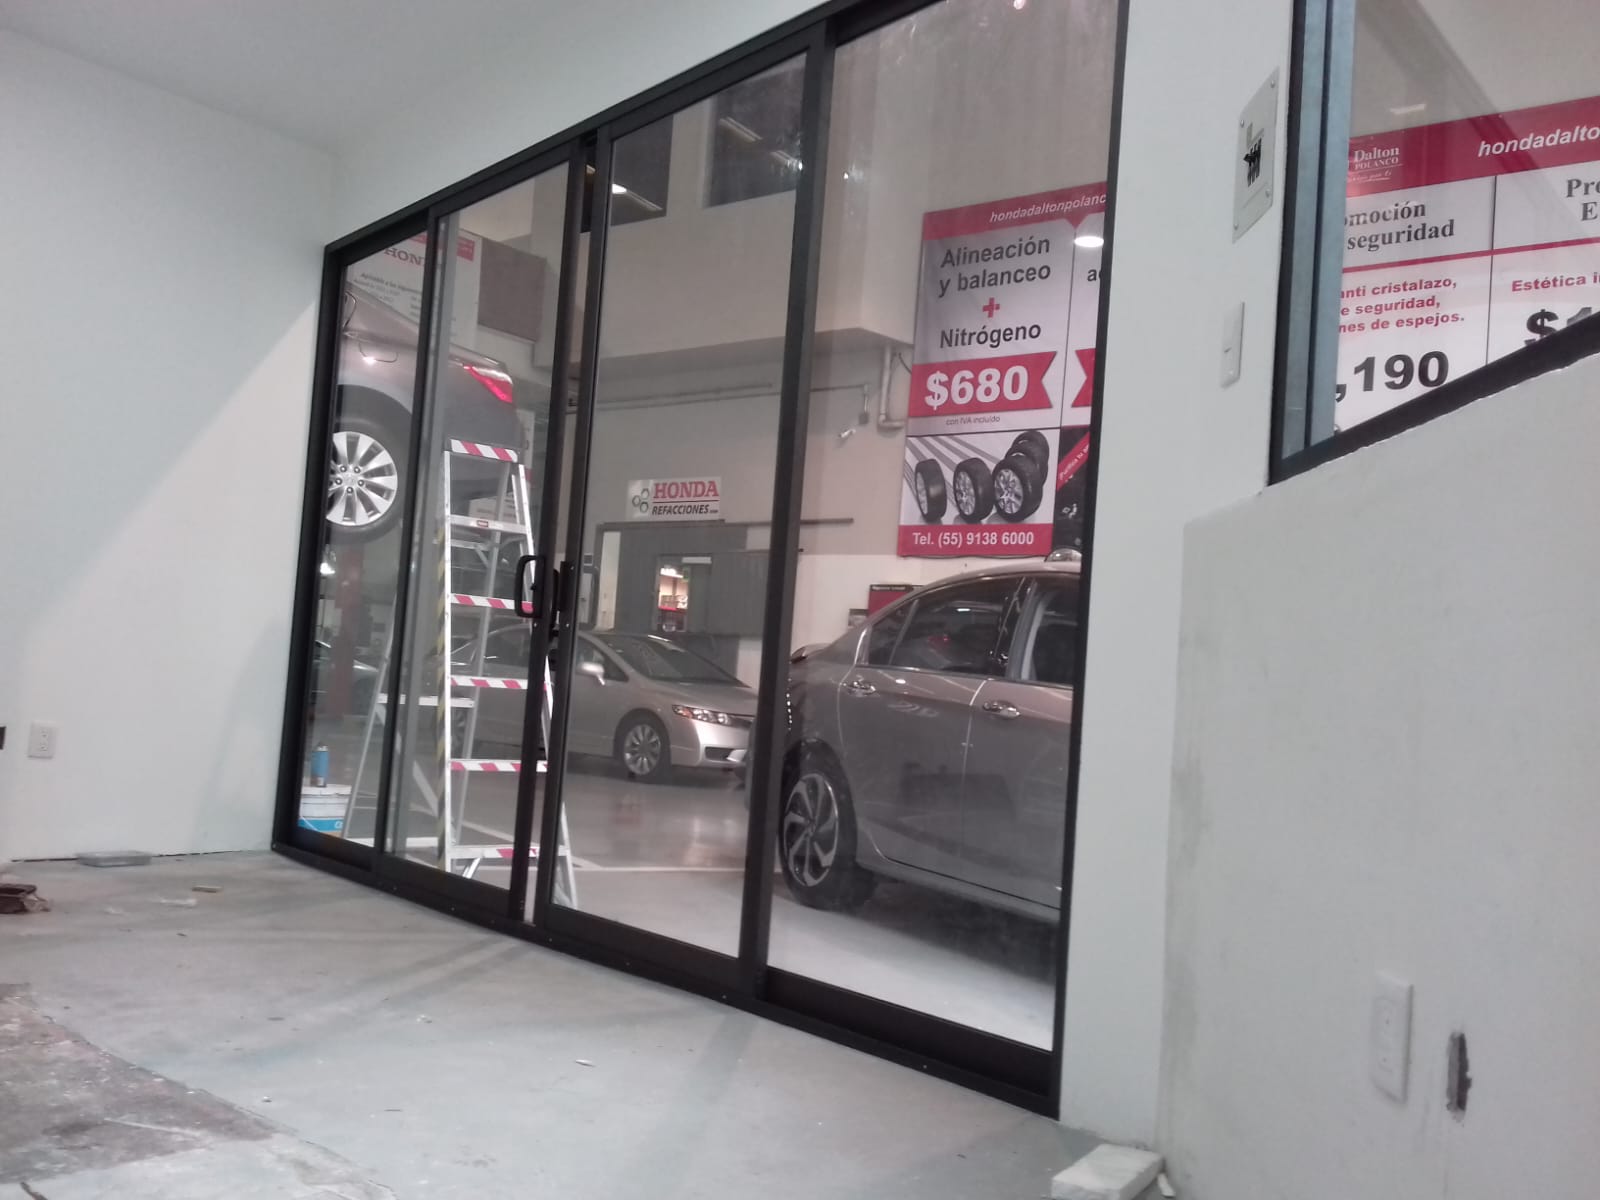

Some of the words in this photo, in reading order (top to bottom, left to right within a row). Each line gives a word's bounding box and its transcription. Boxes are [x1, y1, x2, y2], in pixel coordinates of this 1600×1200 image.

[1478, 125, 1600, 157] hondadalto
[1354, 147, 1400, 162] Dalton
[1343, 201, 1426, 227] moción
[1347, 219, 1455, 252] seguridad
[384, 247, 425, 266] HON
[940, 236, 1050, 268] Alineación
[938, 278, 950, 298] y
[957, 264, 1051, 291] balanceo
[1371, 277, 1457, 296] cristalazo,
[1511, 275, 1586, 292] Estética
[1355, 295, 1441, 315] seguridad,
[1371, 318, 1390, 330] de
[1395, 312, 1465, 328] espejos.
[940, 324, 1041, 349] Nitrógeno
[925, 365, 1029, 410] $680
[653, 480, 720, 499] HONDA
[652, 503, 710, 516] REFACCIONES
[912, 532, 934, 545] Tel.
[938, 532, 963, 548] (55)
[966, 531, 998, 545] 9138
[1001, 531, 1035, 545] 6000
